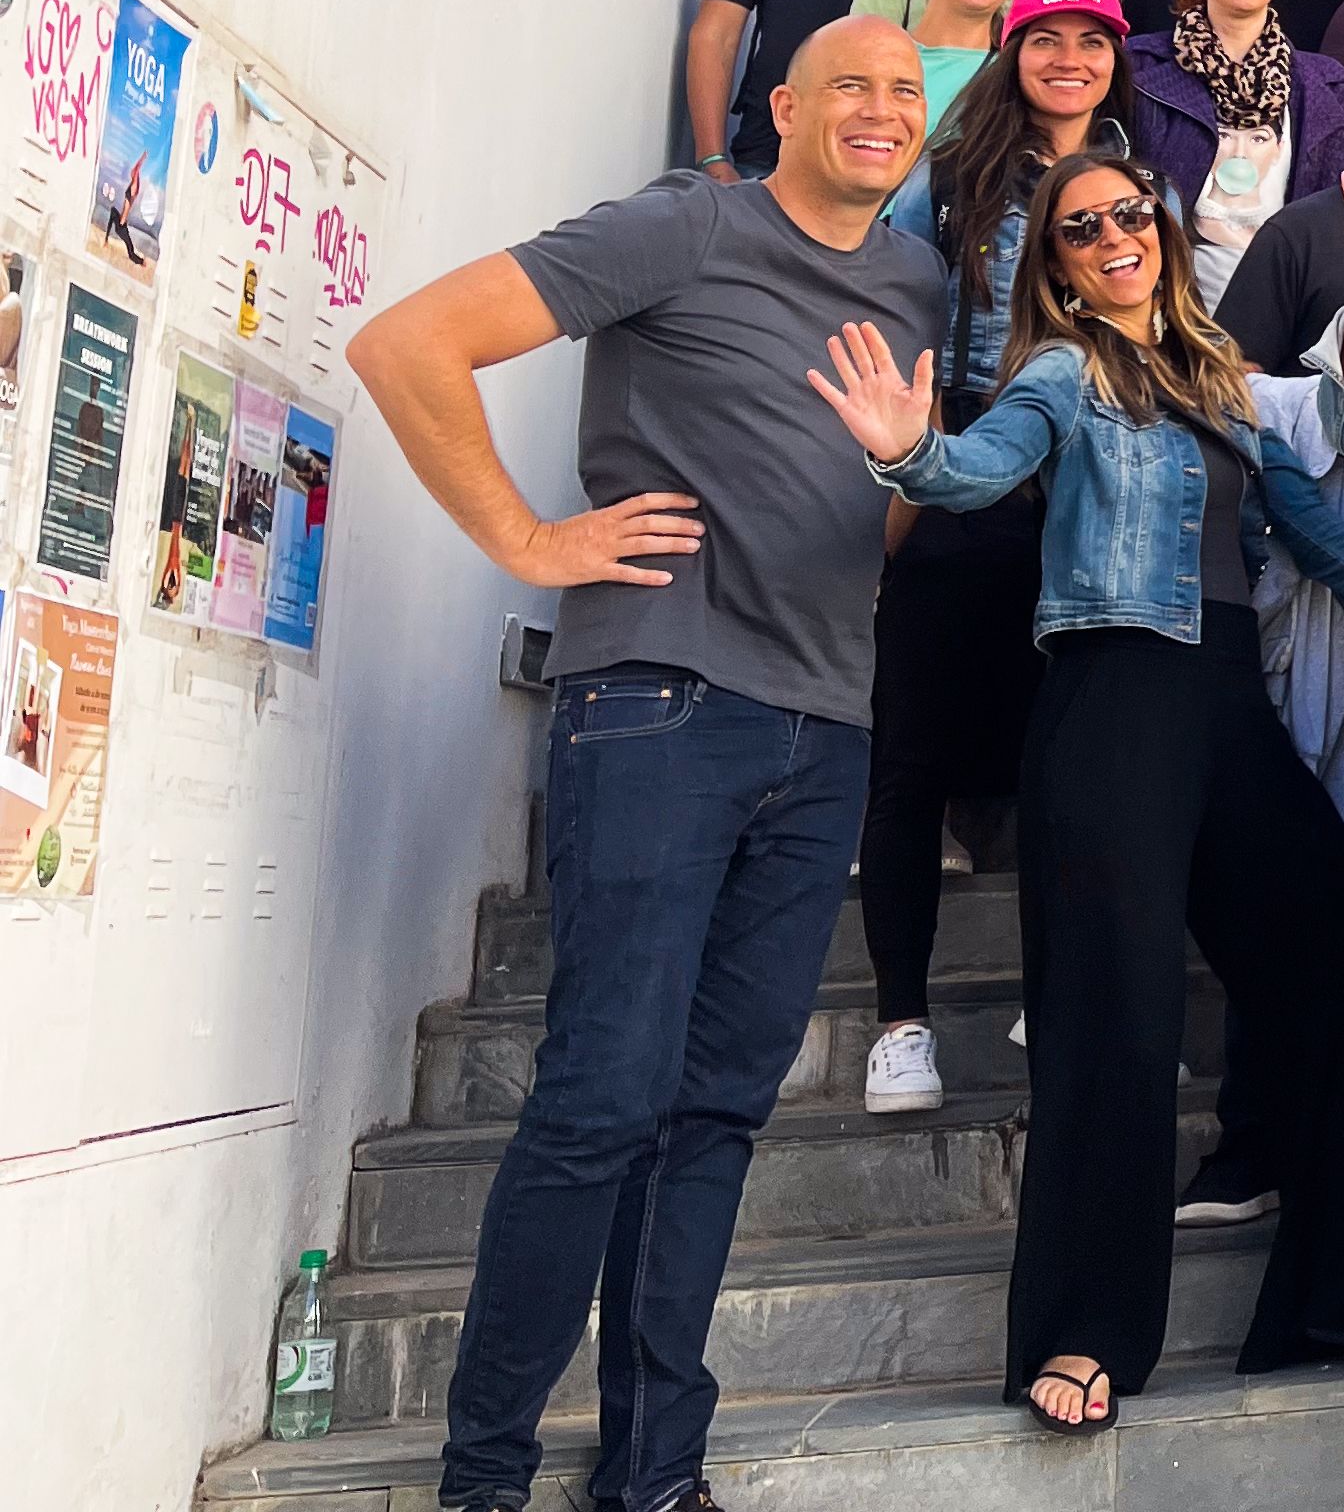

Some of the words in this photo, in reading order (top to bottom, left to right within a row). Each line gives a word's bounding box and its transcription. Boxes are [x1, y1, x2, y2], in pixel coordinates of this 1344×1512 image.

[127, 37, 165, 103] YOGA
[73, 313, 128, 354] BREATHWORK
[80, 346, 113, 375] SESSION
